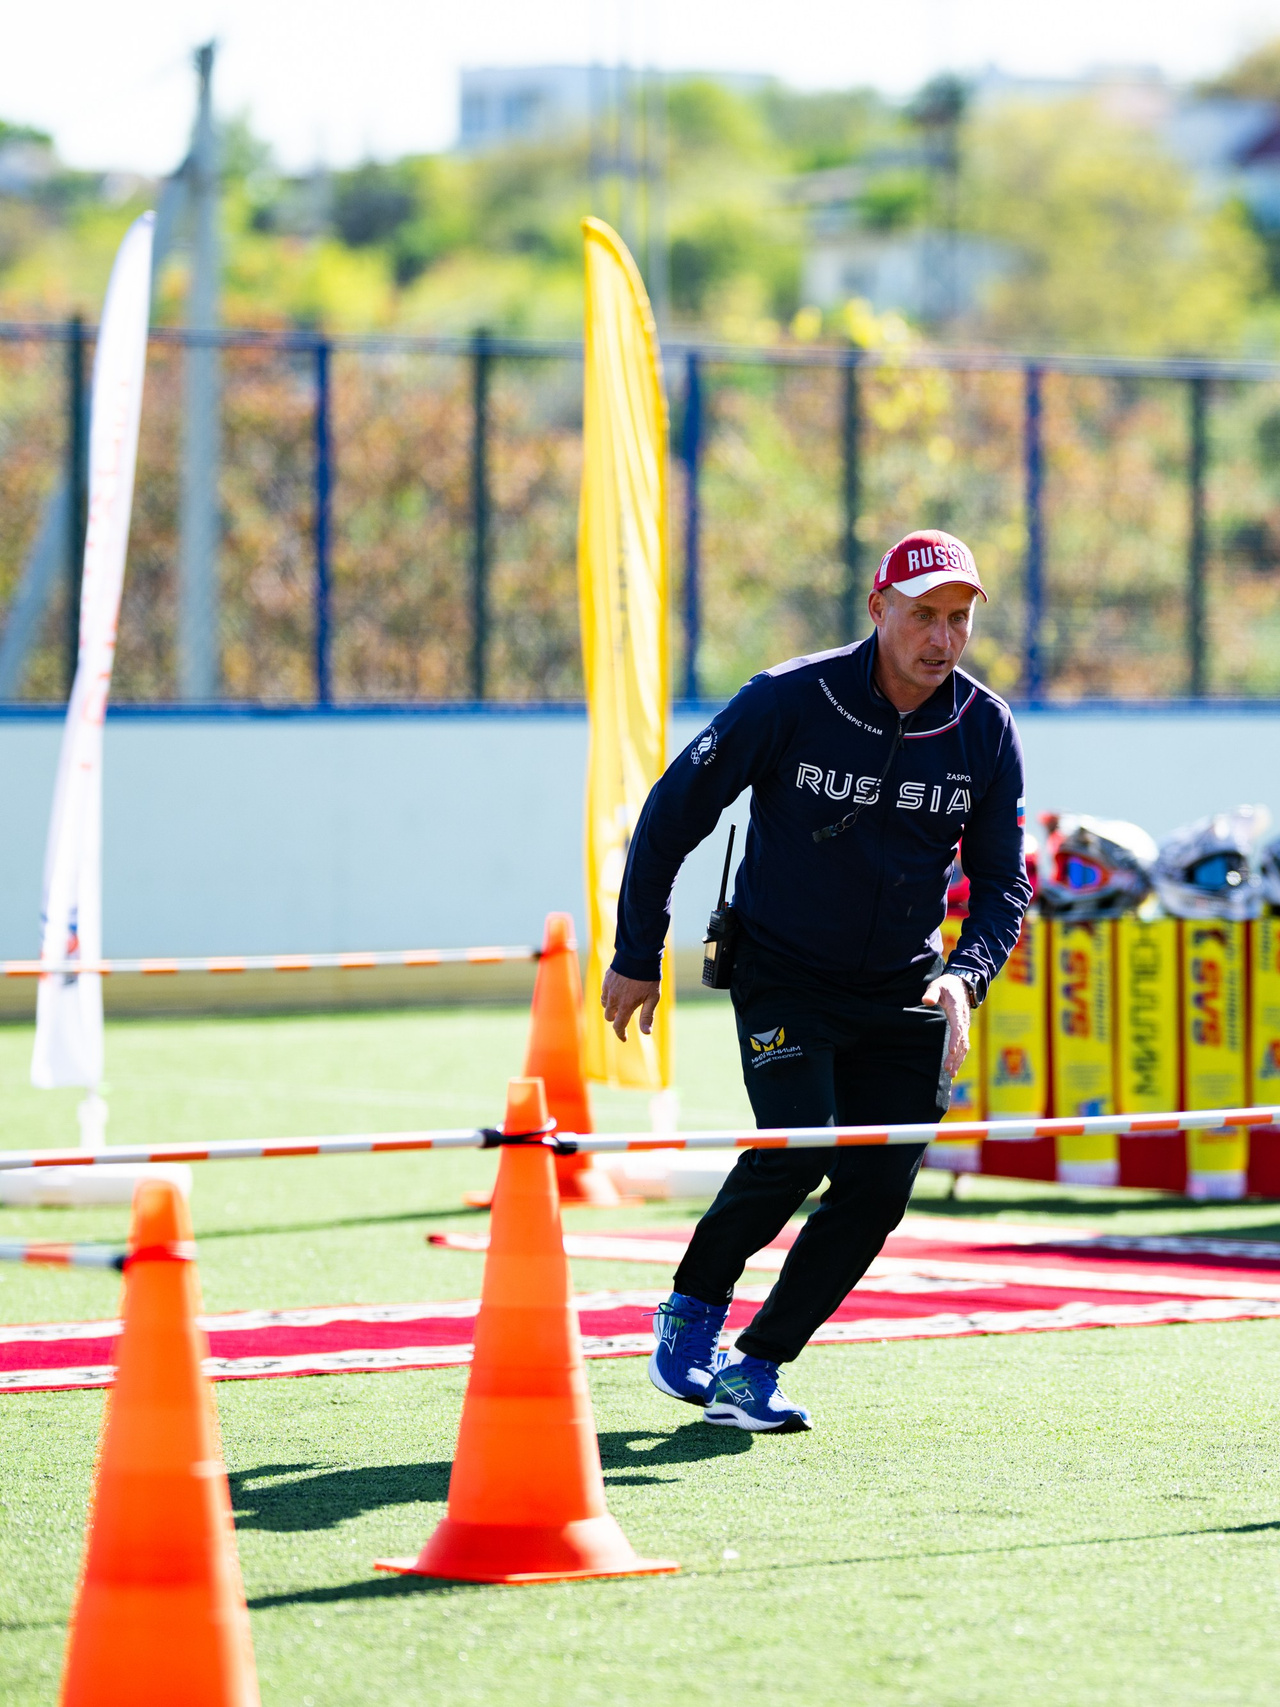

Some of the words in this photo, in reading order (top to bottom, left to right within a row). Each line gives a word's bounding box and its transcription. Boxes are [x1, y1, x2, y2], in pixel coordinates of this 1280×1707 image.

[907, 543, 975, 574] RUSSIA
[818, 678, 839, 707] RUSSIAN
[836, 705, 863, 727] OLYMPIC
[863, 723, 883, 736] TEAM
[946, 772, 973, 783] ZASPO
